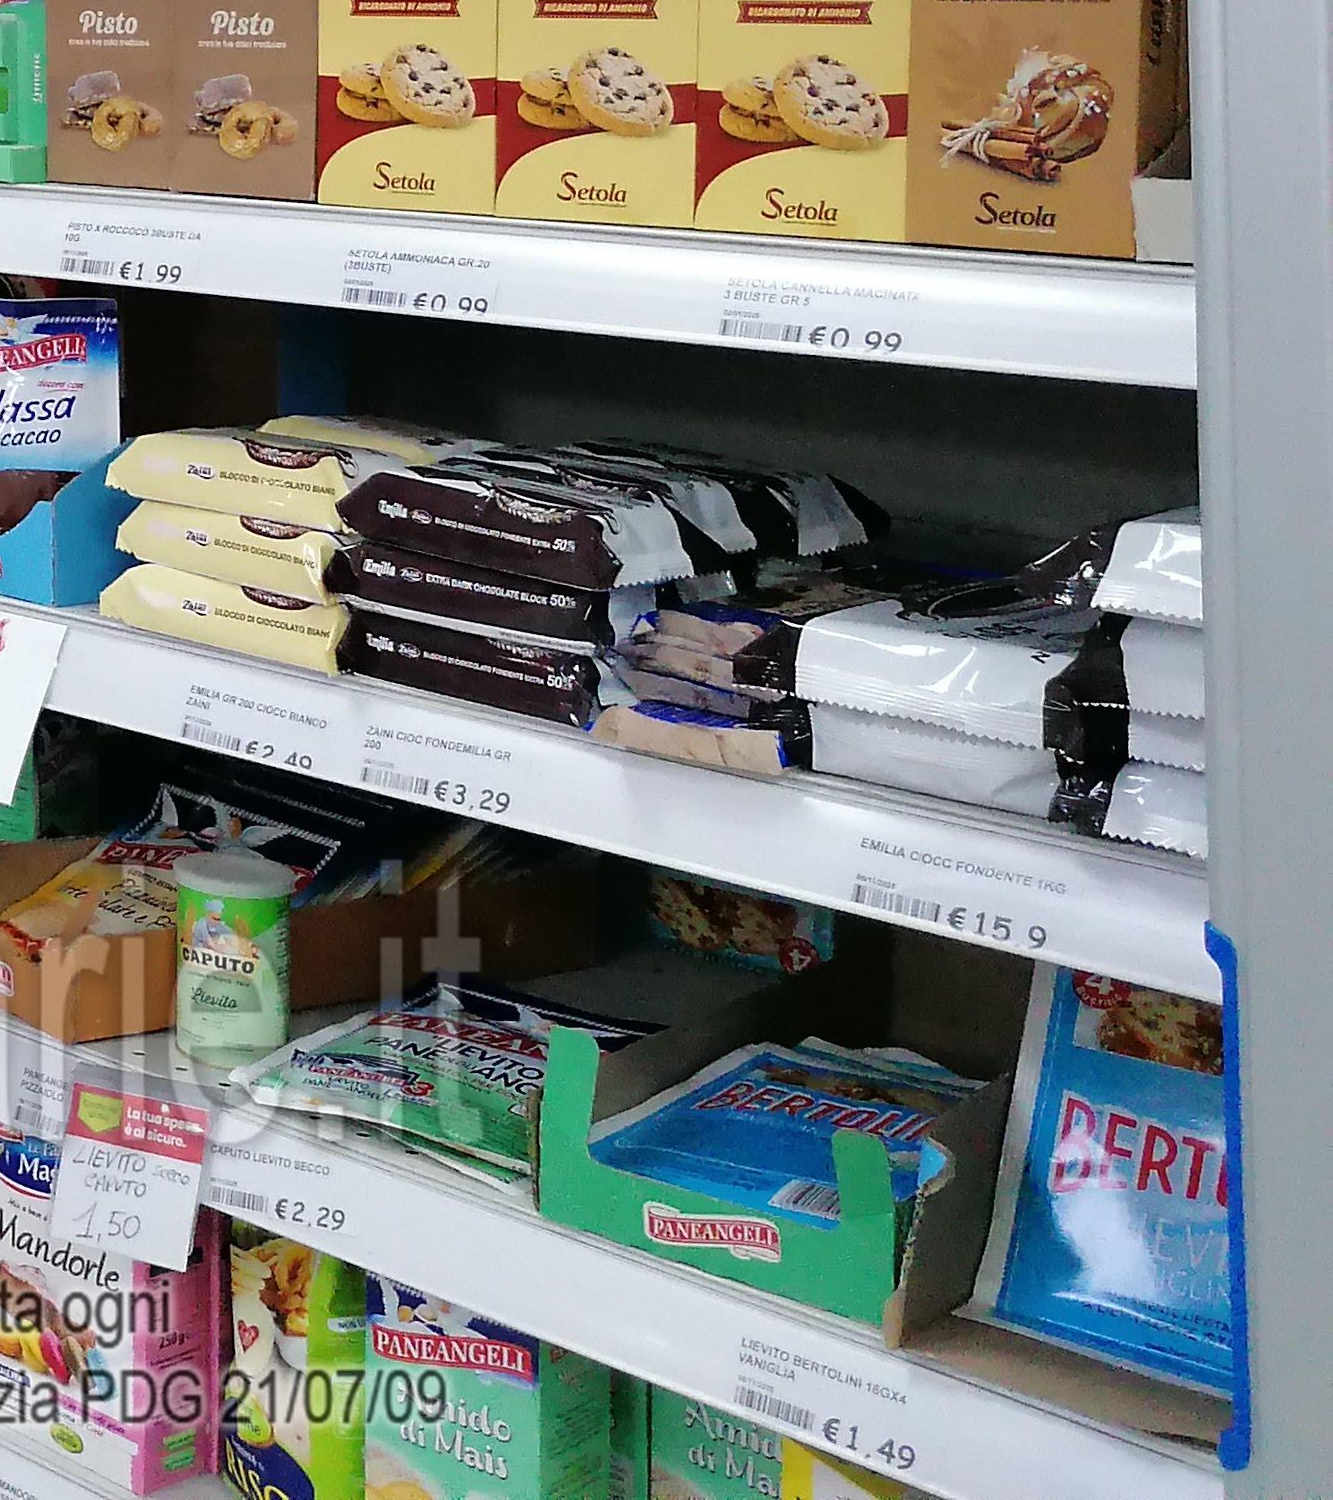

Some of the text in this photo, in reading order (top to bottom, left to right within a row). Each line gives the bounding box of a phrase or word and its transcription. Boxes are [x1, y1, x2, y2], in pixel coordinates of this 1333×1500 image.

[79, 10, 138, 35] Pisto
[211, 10, 275, 37] Pisto
[373, 161, 436, 192] Setola
[557, 172, 627, 203] Setola
[761, 188, 838, 222] Setola
[975, 192, 1057, 229] Setola
[390, 252, 456, 268] AMMONIACA
[0, 429, 62, 447] cacao
[190, 684, 327, 729] EMILIA BIANCO
[365, 725, 394, 740] ZAINI
[860, 837, 1033, 887] EMILIA FONDENTE
[182, 946, 254, 974] CAPUTO
[191, 986, 238, 1009] Lievito
[72, 1145, 146, 1173] LIEVITO
[211, 1143, 330, 1176] CAPUTO LIEVITO SECCO
[76, 1201, 141, 1242] 1,50
[653, 1216, 776, 1247] PANEANGELI
[378, 1331, 524, 1373] PANEANGELI
[738, 1352, 796, 1383] VANIGLIA
[741, 1337, 864, 1390] LIEVITO BERTOLINI
[400, 1422, 507, 1480] di Mais
